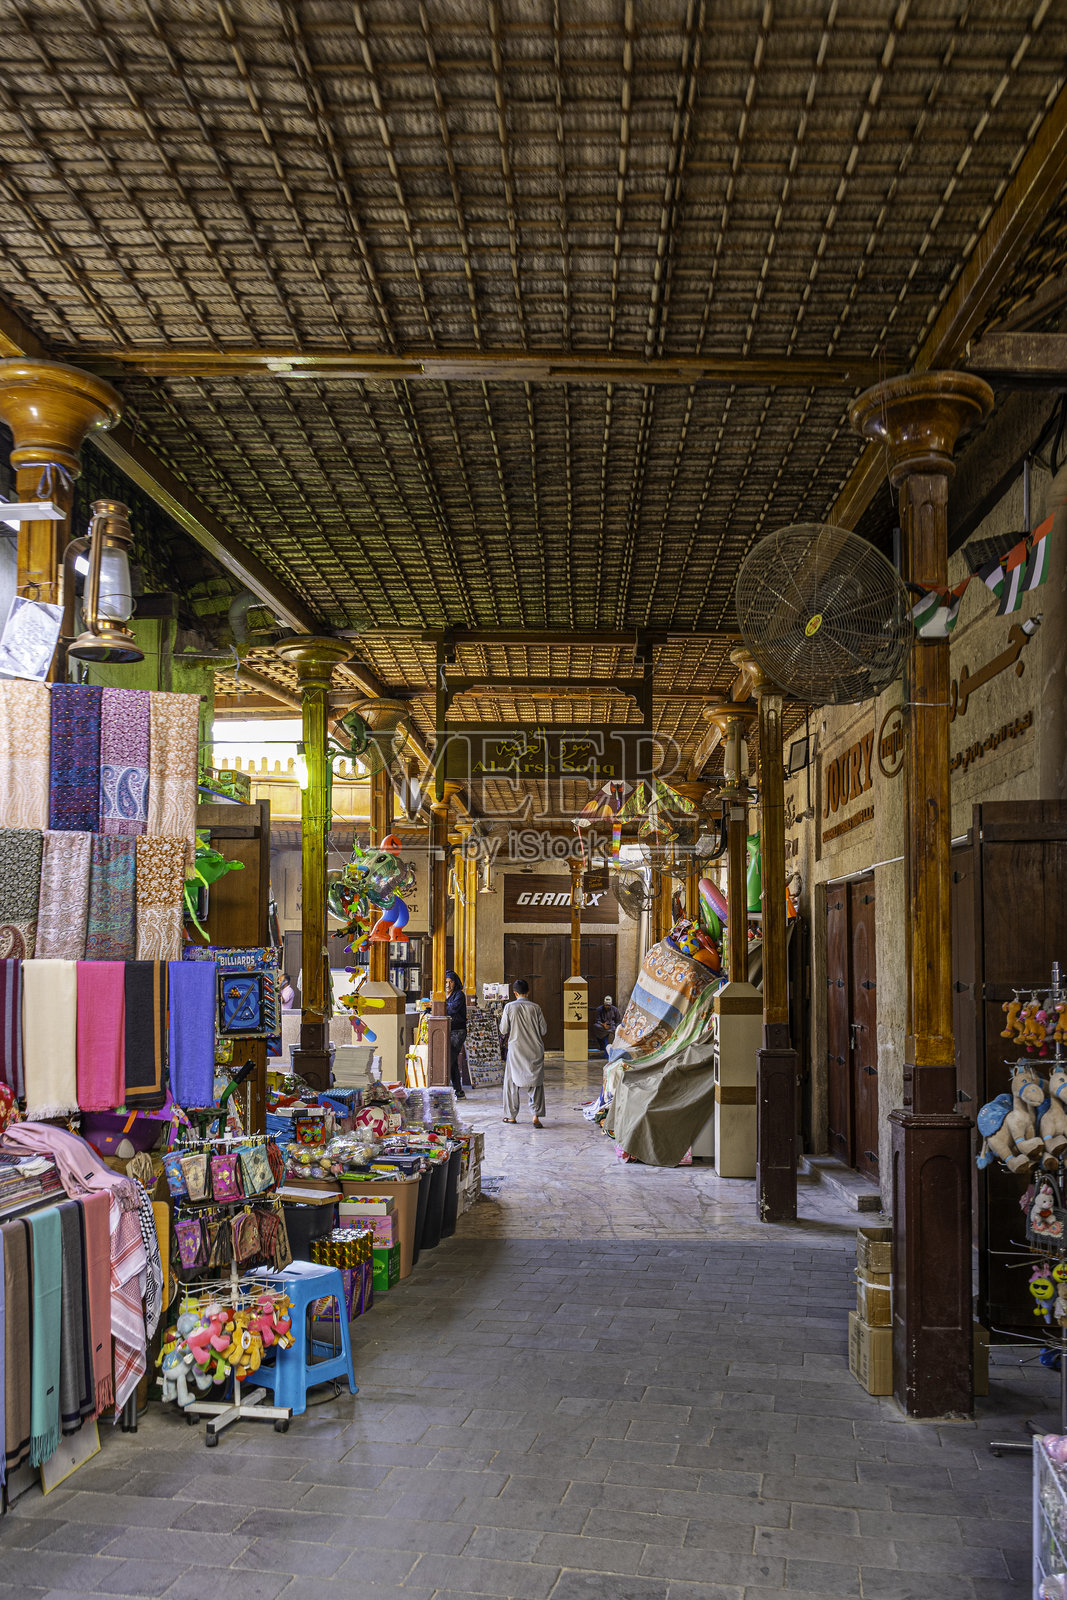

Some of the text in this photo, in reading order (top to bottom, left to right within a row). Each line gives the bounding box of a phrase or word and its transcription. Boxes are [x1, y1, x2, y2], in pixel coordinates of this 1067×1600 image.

[472, 760, 616, 776] Al-Arsa Souq
[823, 729, 874, 819] JOURY
[220, 955, 255, 966] BILLIARDS
